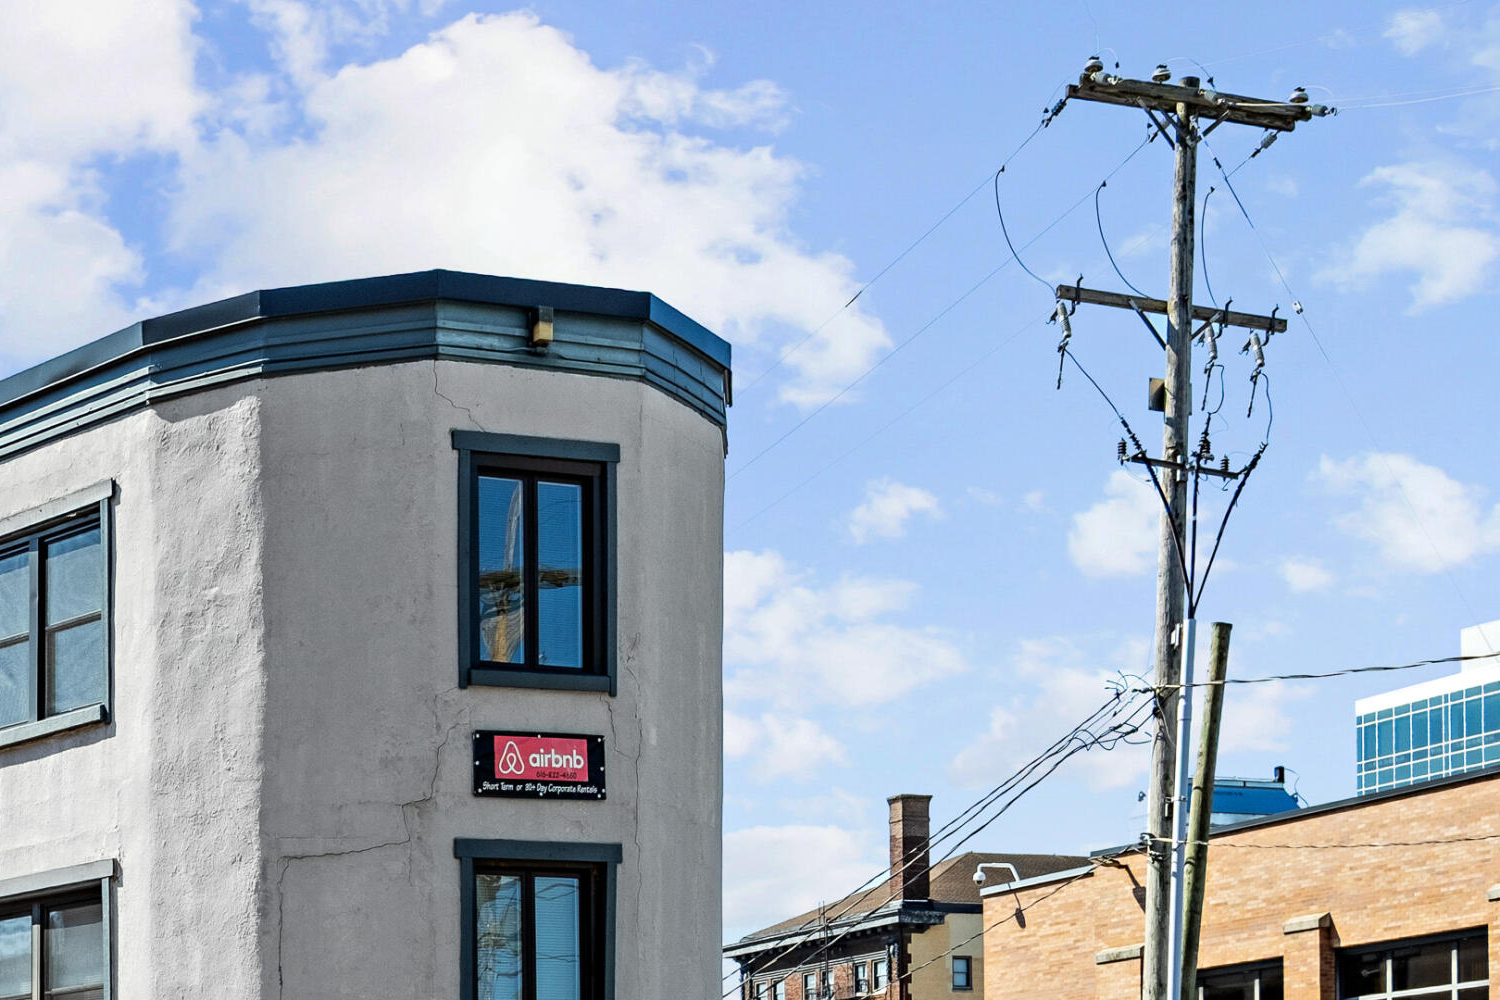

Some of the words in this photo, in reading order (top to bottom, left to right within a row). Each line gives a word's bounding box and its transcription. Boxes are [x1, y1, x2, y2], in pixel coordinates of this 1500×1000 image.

[529, 748, 584, 769] airbnb
[482, 781, 499, 790] Short
[501, 782, 514, 790] Term
[524, 783, 536, 791] 30+
[537, 783, 548, 793] Day
[548, 783, 576, 794] Corporate
[576, 784, 598, 793] Rentals
